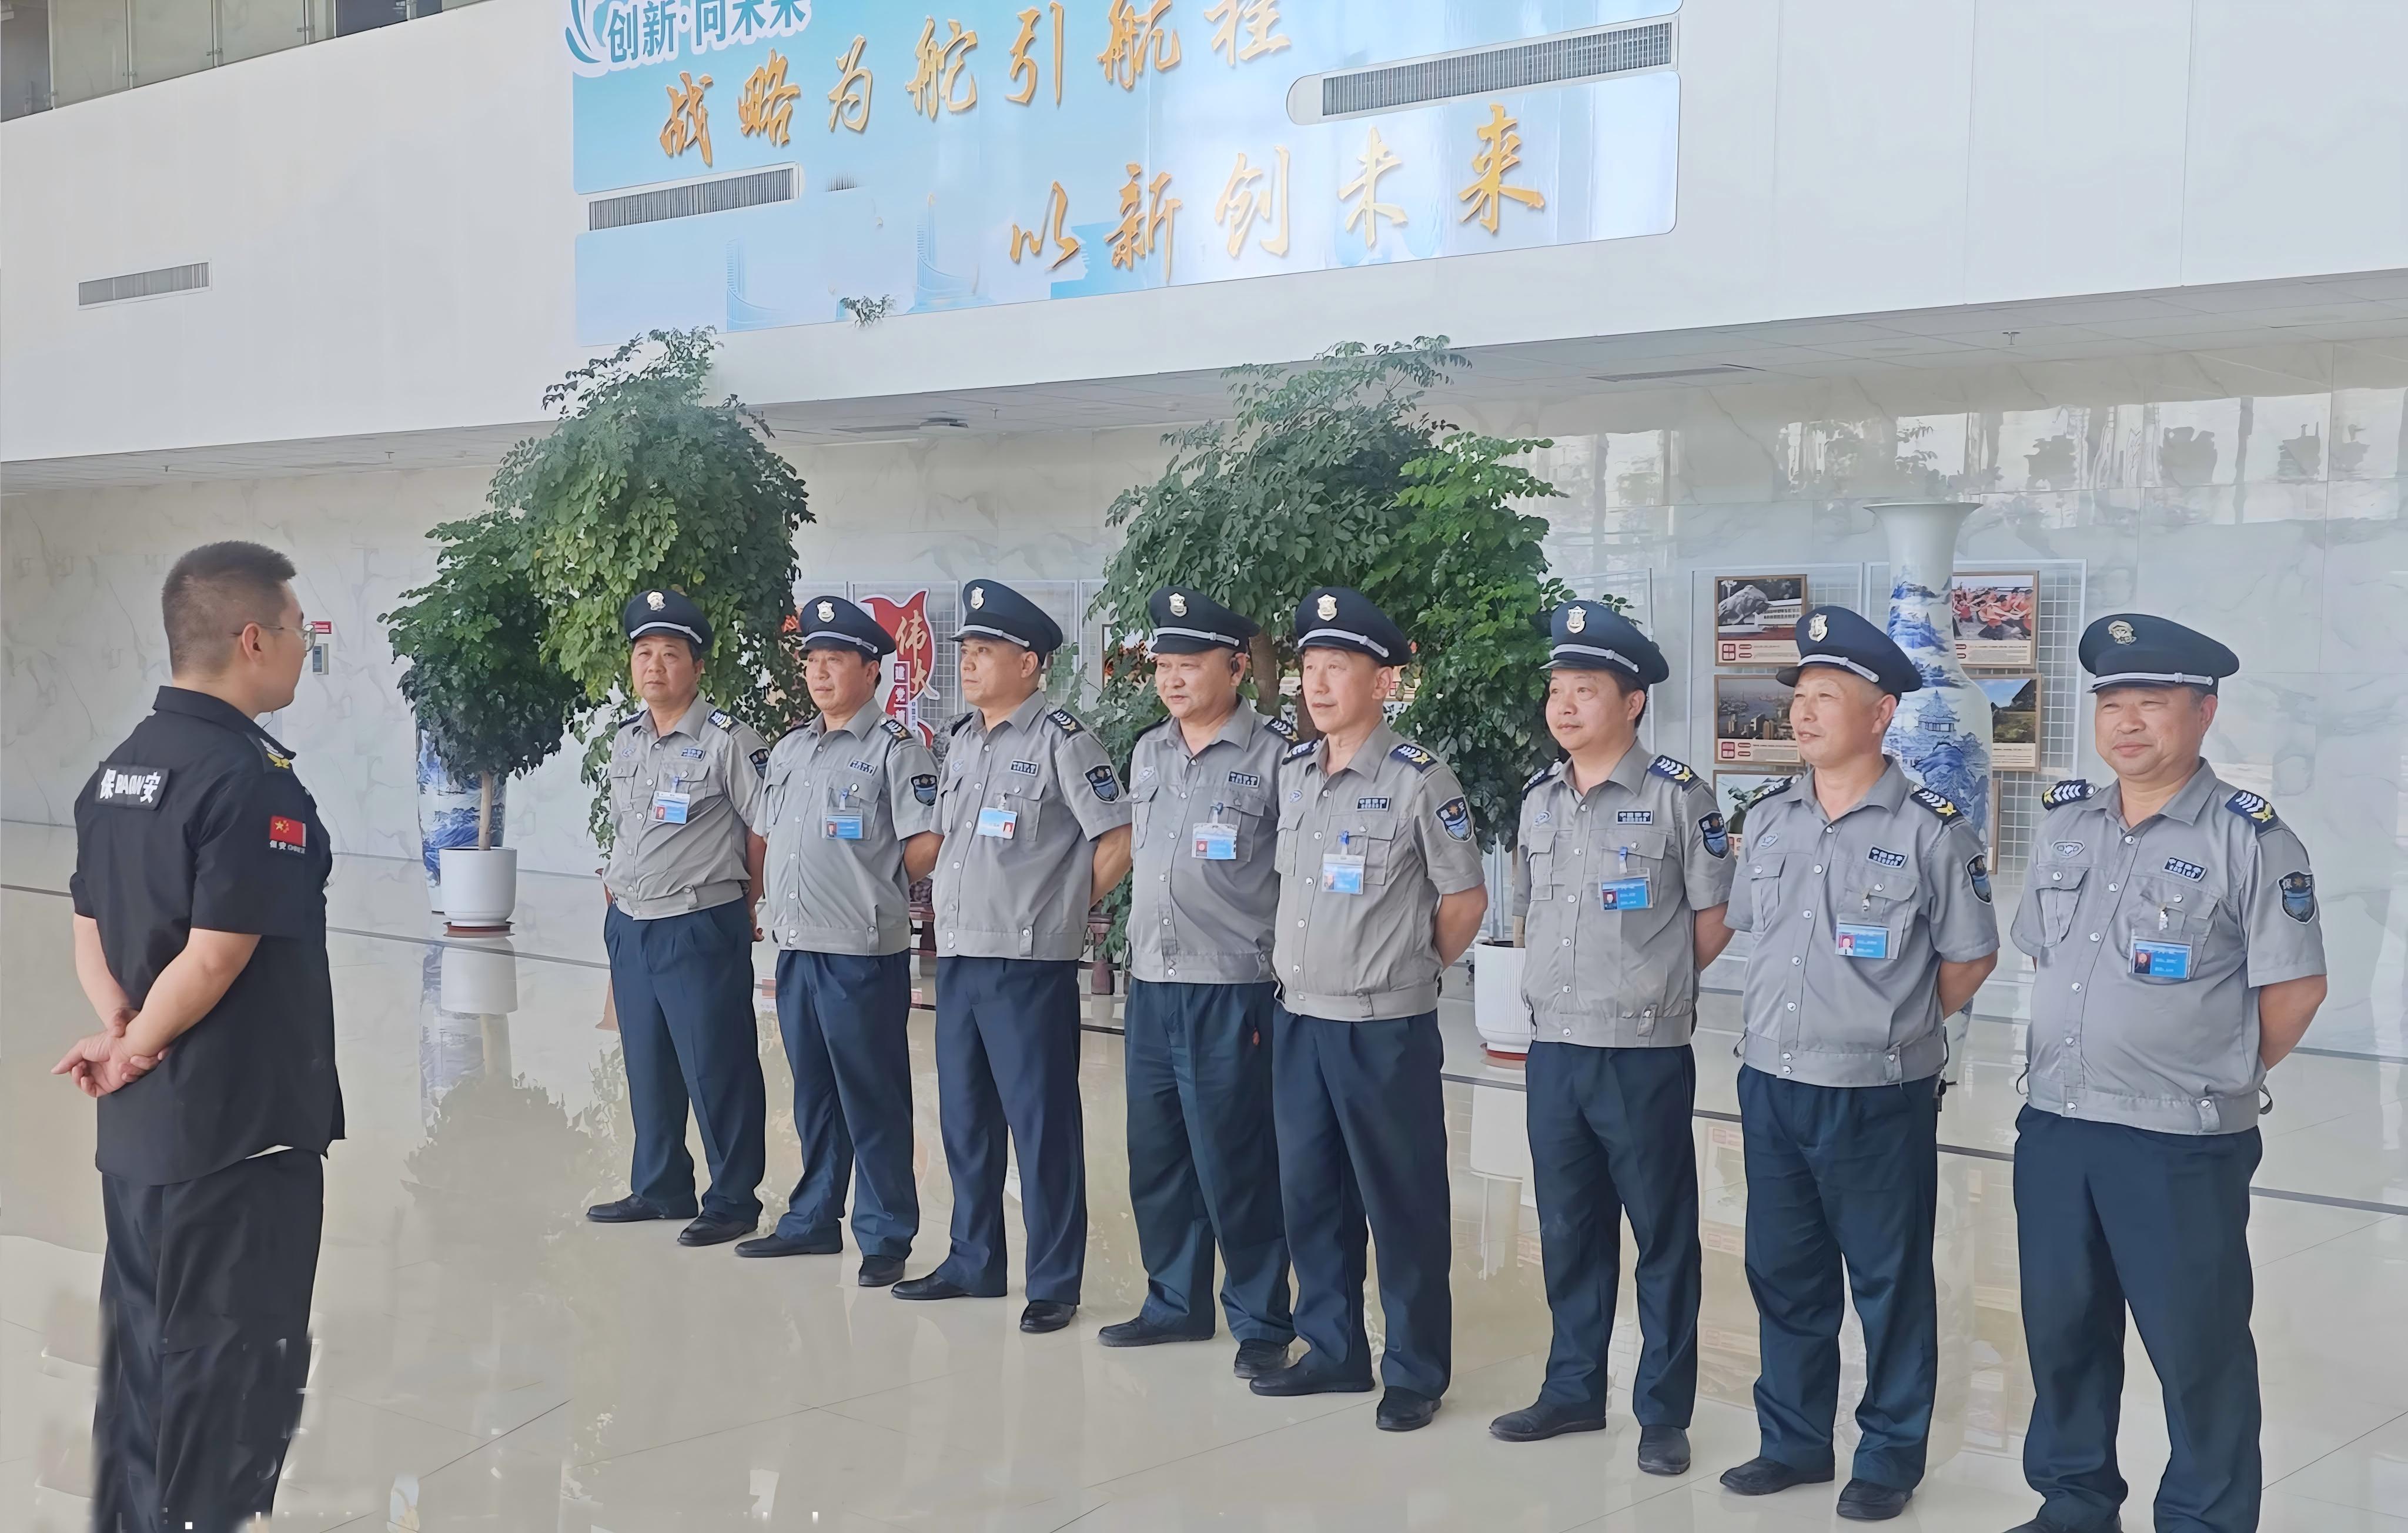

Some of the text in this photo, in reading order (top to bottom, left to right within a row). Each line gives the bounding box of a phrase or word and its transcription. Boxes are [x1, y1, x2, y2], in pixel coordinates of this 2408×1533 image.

[1009, 103, 1546, 283] 以新创未来
